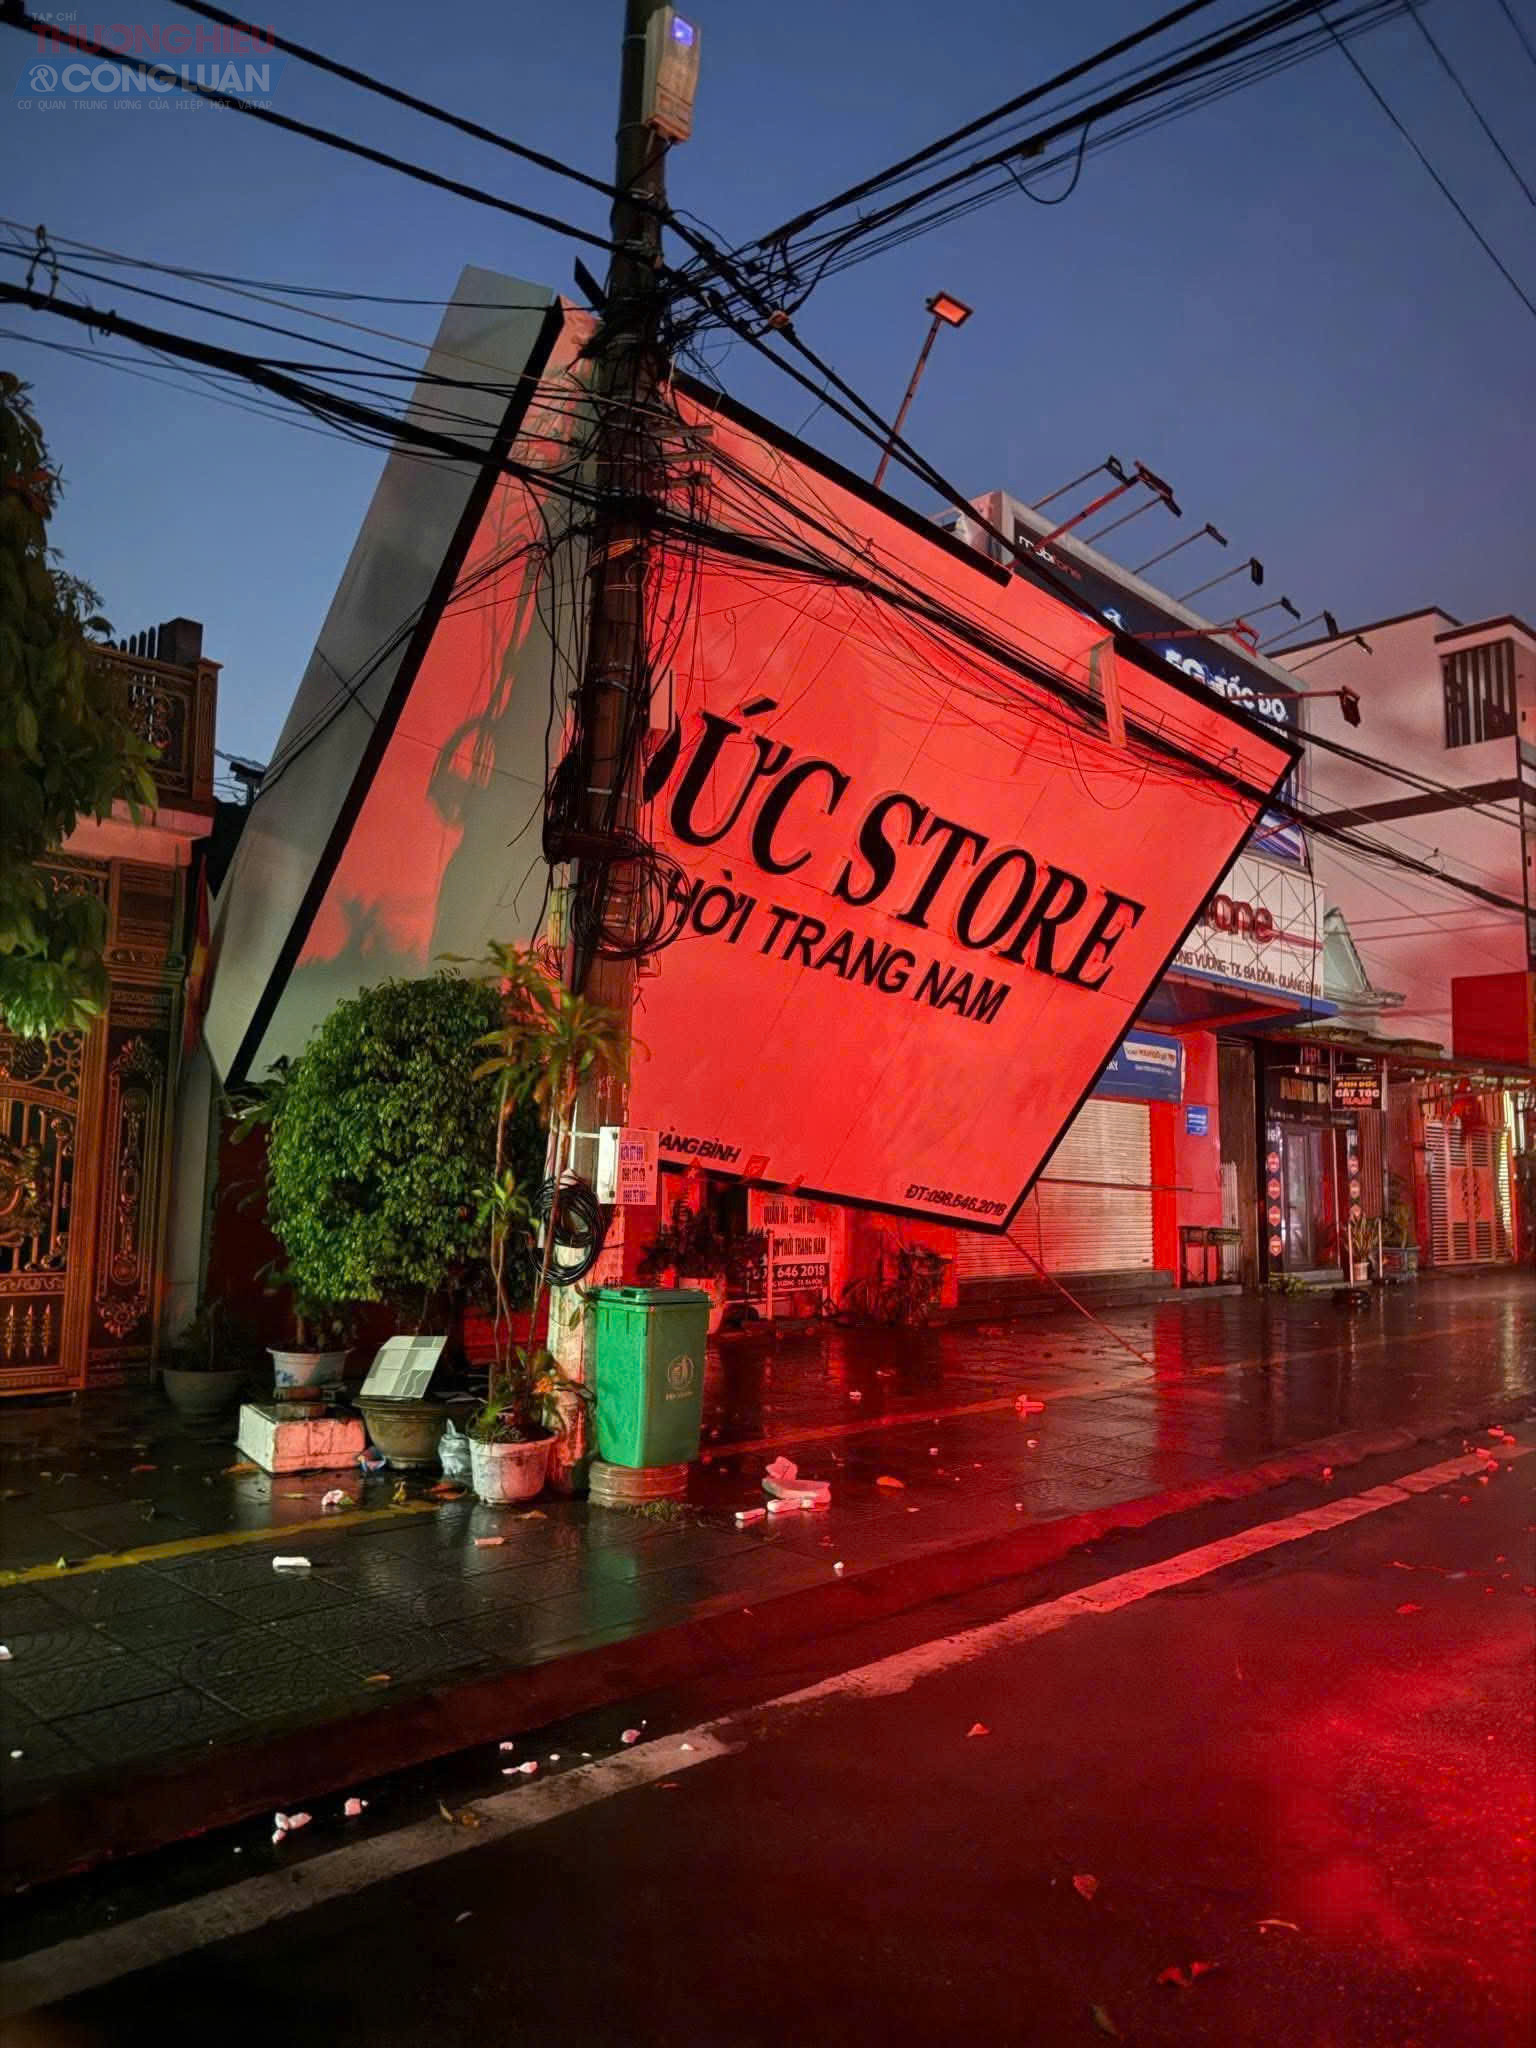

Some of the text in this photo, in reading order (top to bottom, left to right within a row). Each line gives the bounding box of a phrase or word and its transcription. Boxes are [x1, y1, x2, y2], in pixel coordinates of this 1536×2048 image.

[832, 792, 1146, 992] STORE
[1203, 894, 1273, 943] one
[667, 866, 1011, 1025] HỜI TRANG NAM
[659, 1126, 700, 1155] ẢNG
[696, 1137, 742, 1163] BÌNH
[777, 1266, 799, 1278] 646
[800, 1264, 826, 1277] 2018
